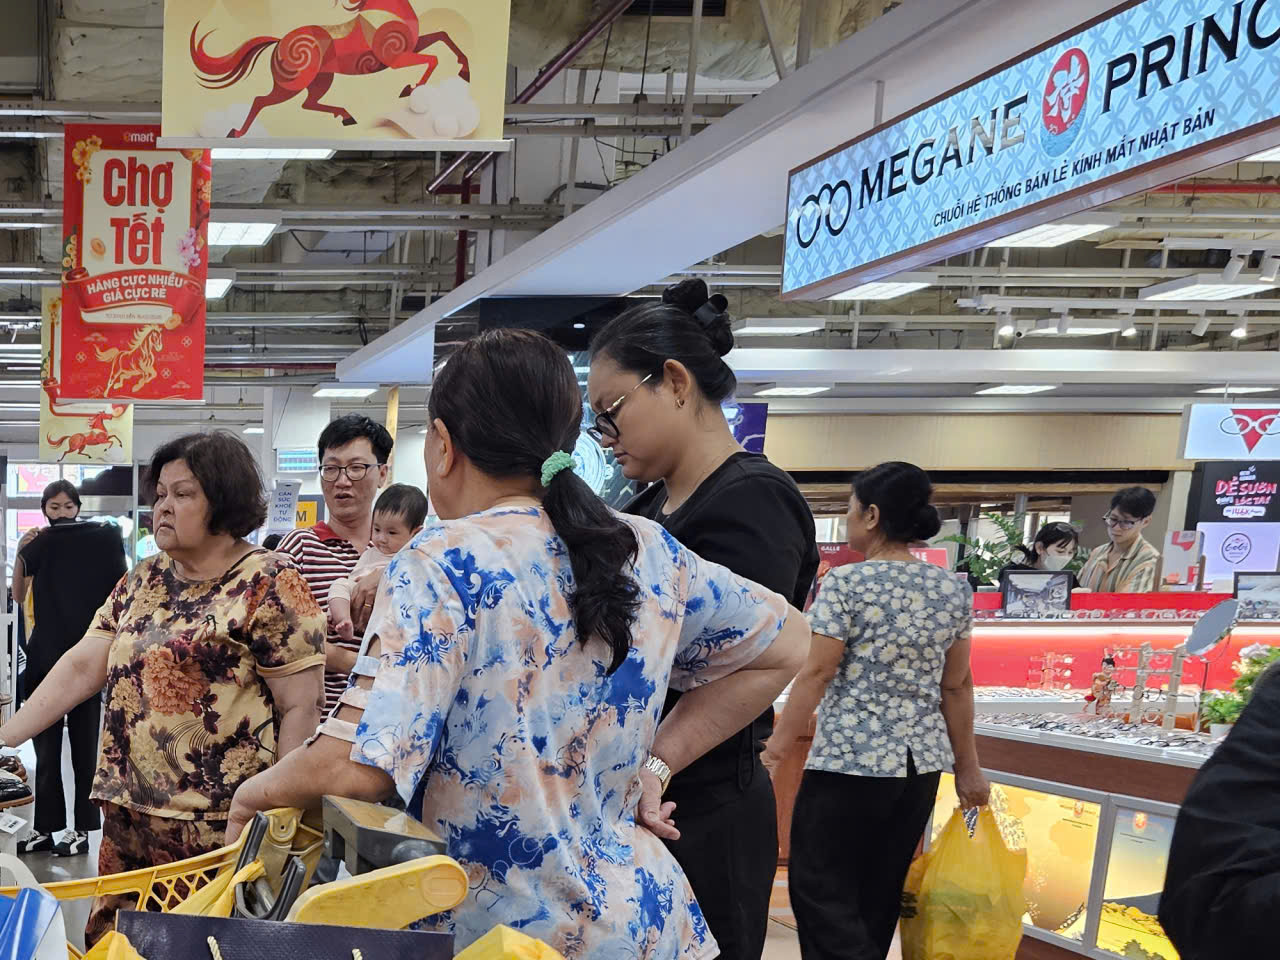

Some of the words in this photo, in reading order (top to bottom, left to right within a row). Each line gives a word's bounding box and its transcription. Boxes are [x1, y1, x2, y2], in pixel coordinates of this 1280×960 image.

[124, 132, 154, 143] emart
[858, 94, 1028, 210] MEGANE
[103, 156, 174, 214] Chợ
[933, 199, 965, 227] CHUỖI
[966, 194, 981, 217] HỆ
[985, 181, 1022, 209] THỐNG
[1025, 170, 1050, 194] BÁN
[1052, 159, 1069, 184] LẺ
[1071, 152, 1102, 177] KÍNH
[1105, 135, 1136, 165] MẮT
[1138, 122, 1180, 153] NHẬT
[1182, 107, 1215, 136] BẢN
[110, 211, 165, 265] Tết
[87, 276, 119, 295] HÀNG
[121, 274, 146, 291] CỰC
[102, 289, 125, 303] GIÁ
[125, 288, 150, 302] CỰC
